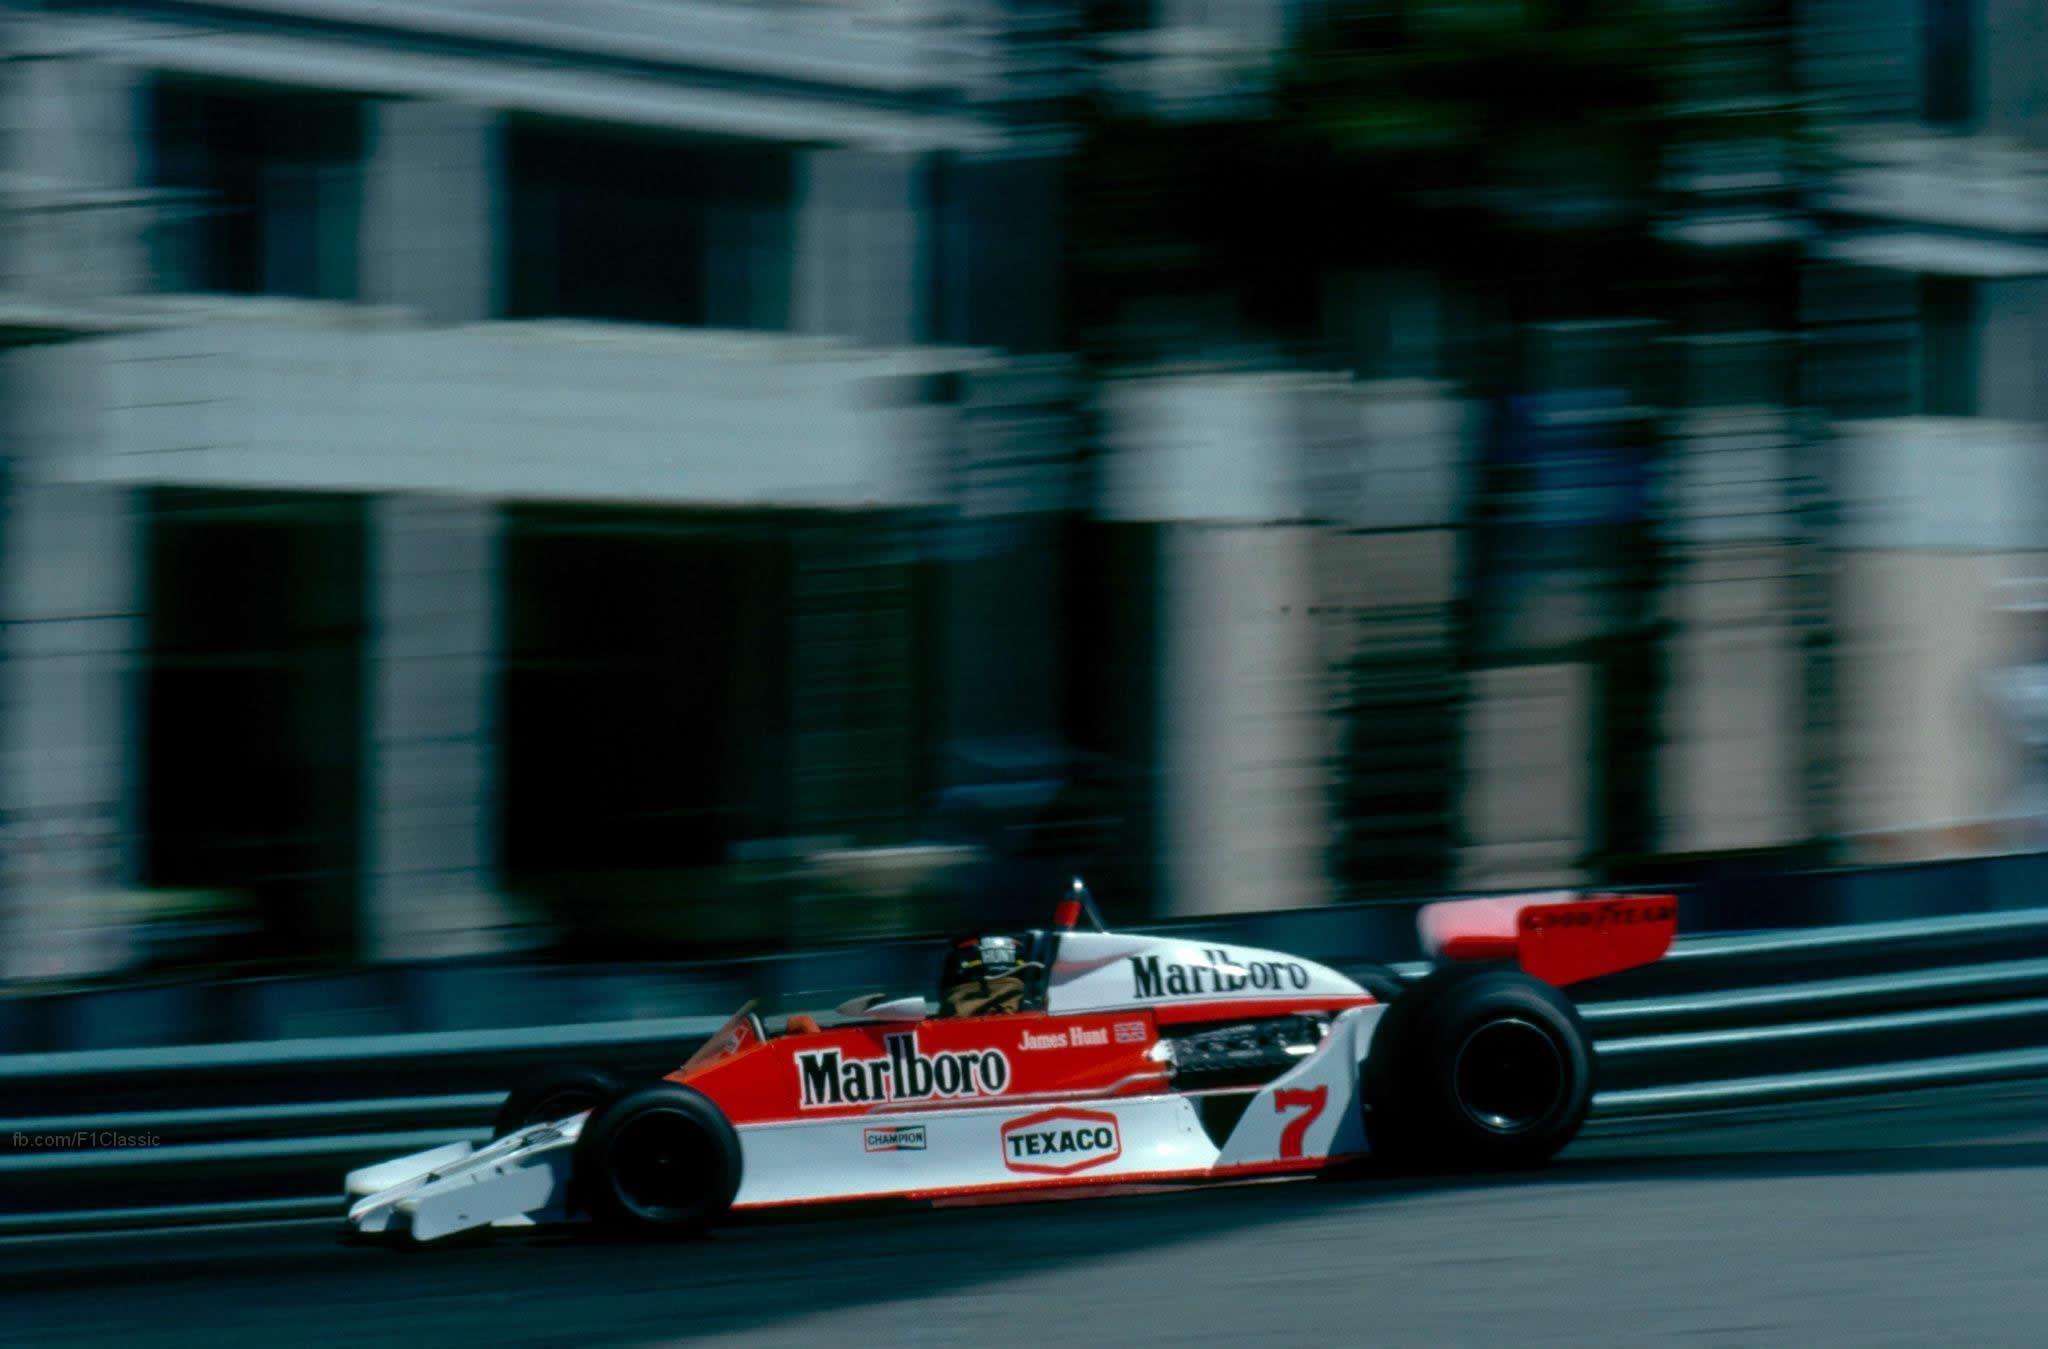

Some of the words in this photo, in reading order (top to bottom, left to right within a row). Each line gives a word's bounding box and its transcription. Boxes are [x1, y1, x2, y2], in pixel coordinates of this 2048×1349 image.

[1128, 949, 1310, 999] Marlboro
[1018, 1028, 1068, 1050] James
[1070, 1025, 1108, 1048] Hunt
[799, 1032, 1008, 1106] Marlboro
[867, 1132, 924, 1147] CHAMPION
[1007, 1127, 1113, 1157] TEXACO
[1274, 1085, 1328, 1159] 7
